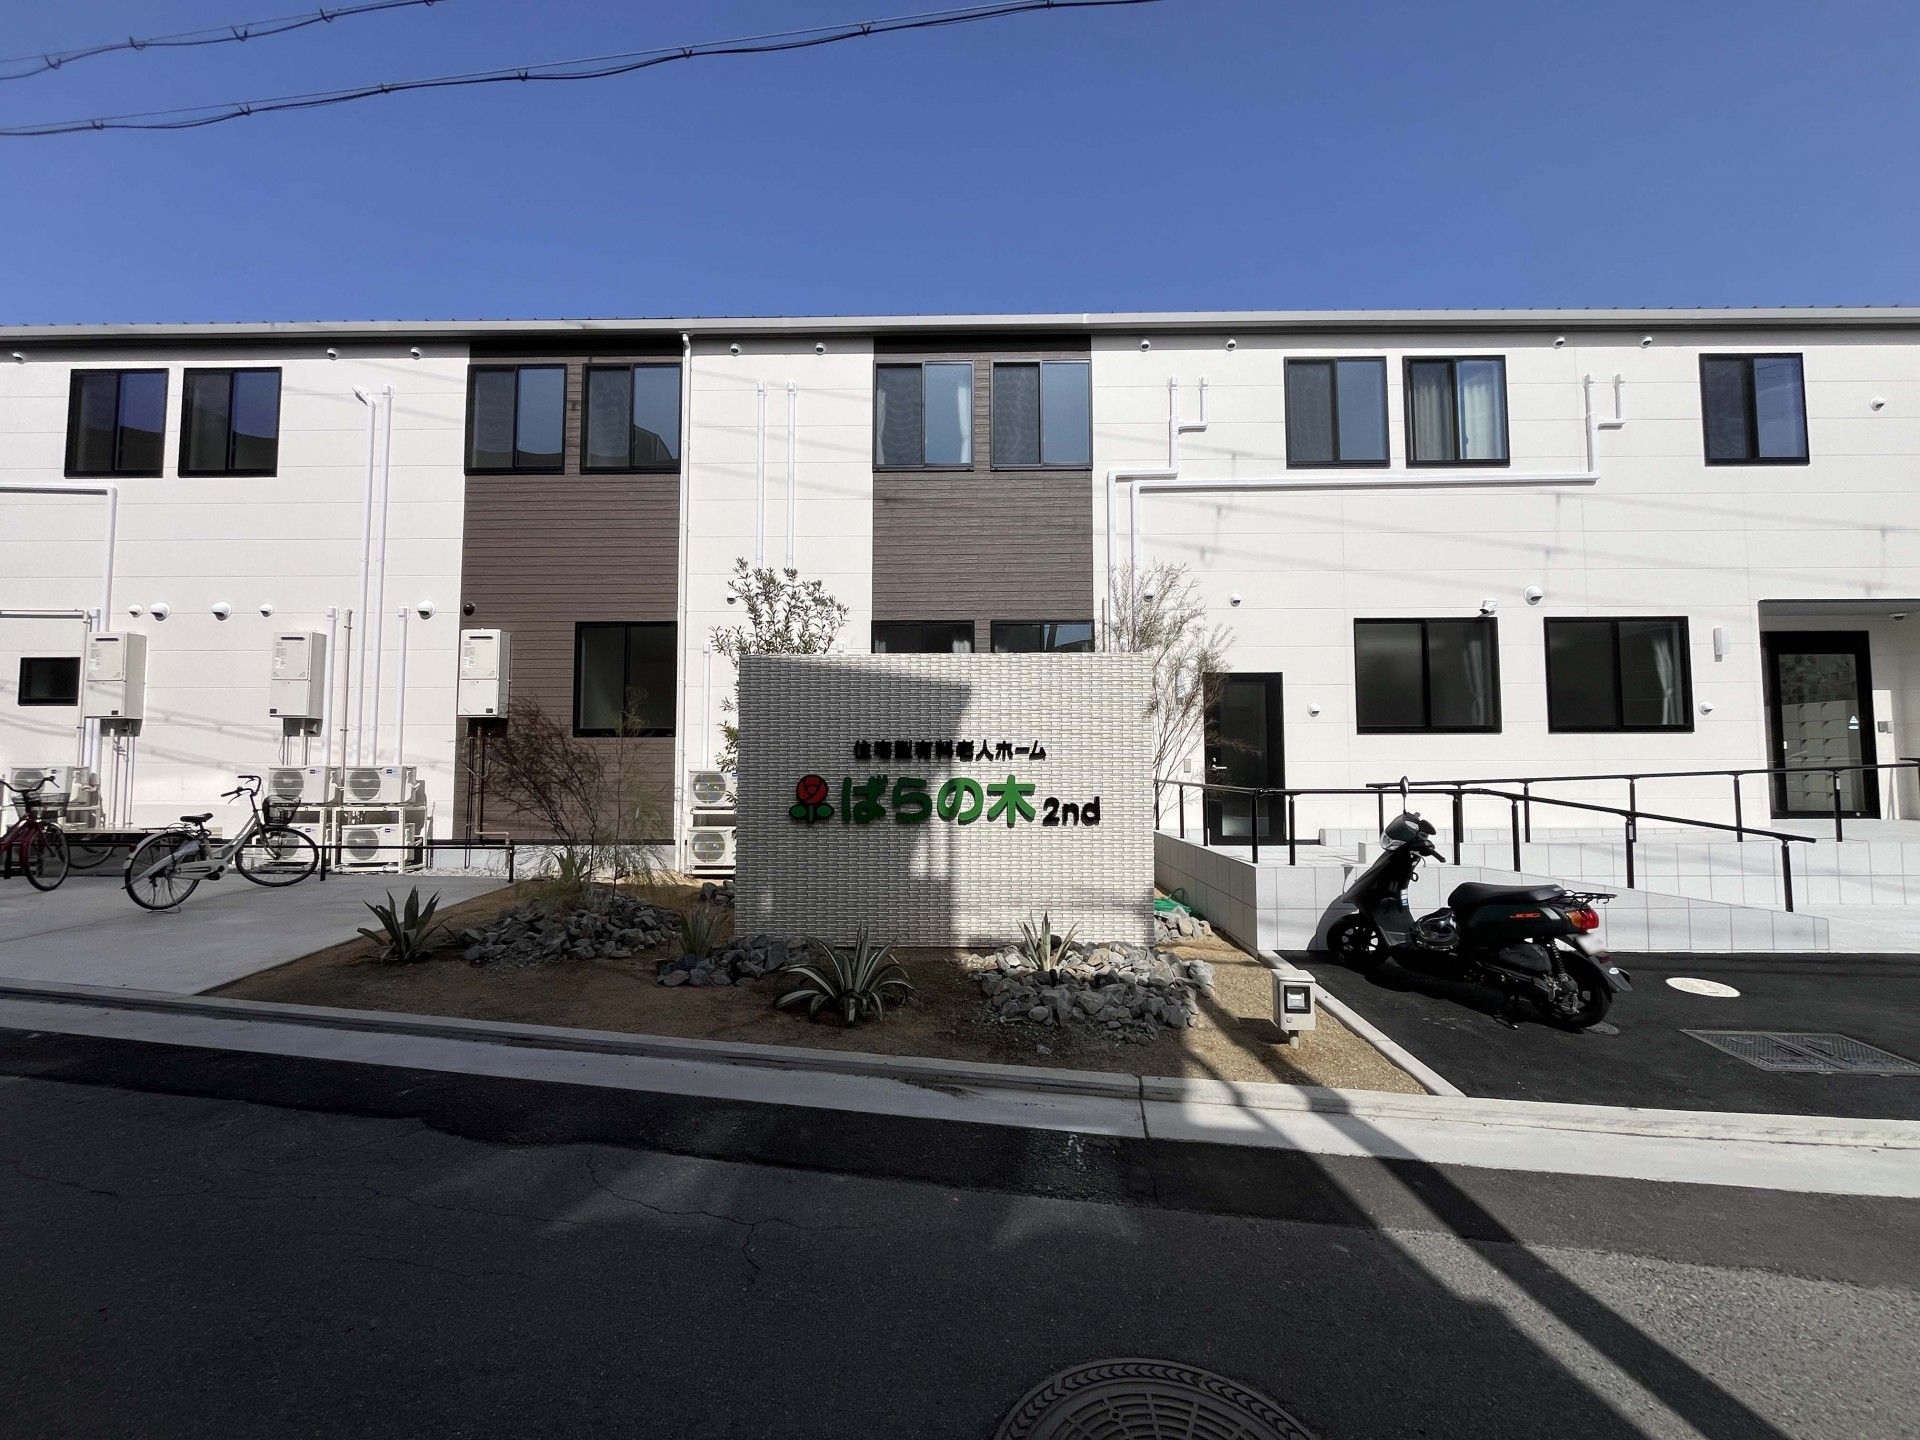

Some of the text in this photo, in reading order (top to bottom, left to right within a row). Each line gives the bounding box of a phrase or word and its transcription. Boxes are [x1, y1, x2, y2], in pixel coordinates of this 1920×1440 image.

[841, 774, 1101, 828] ばらの木 2nd
